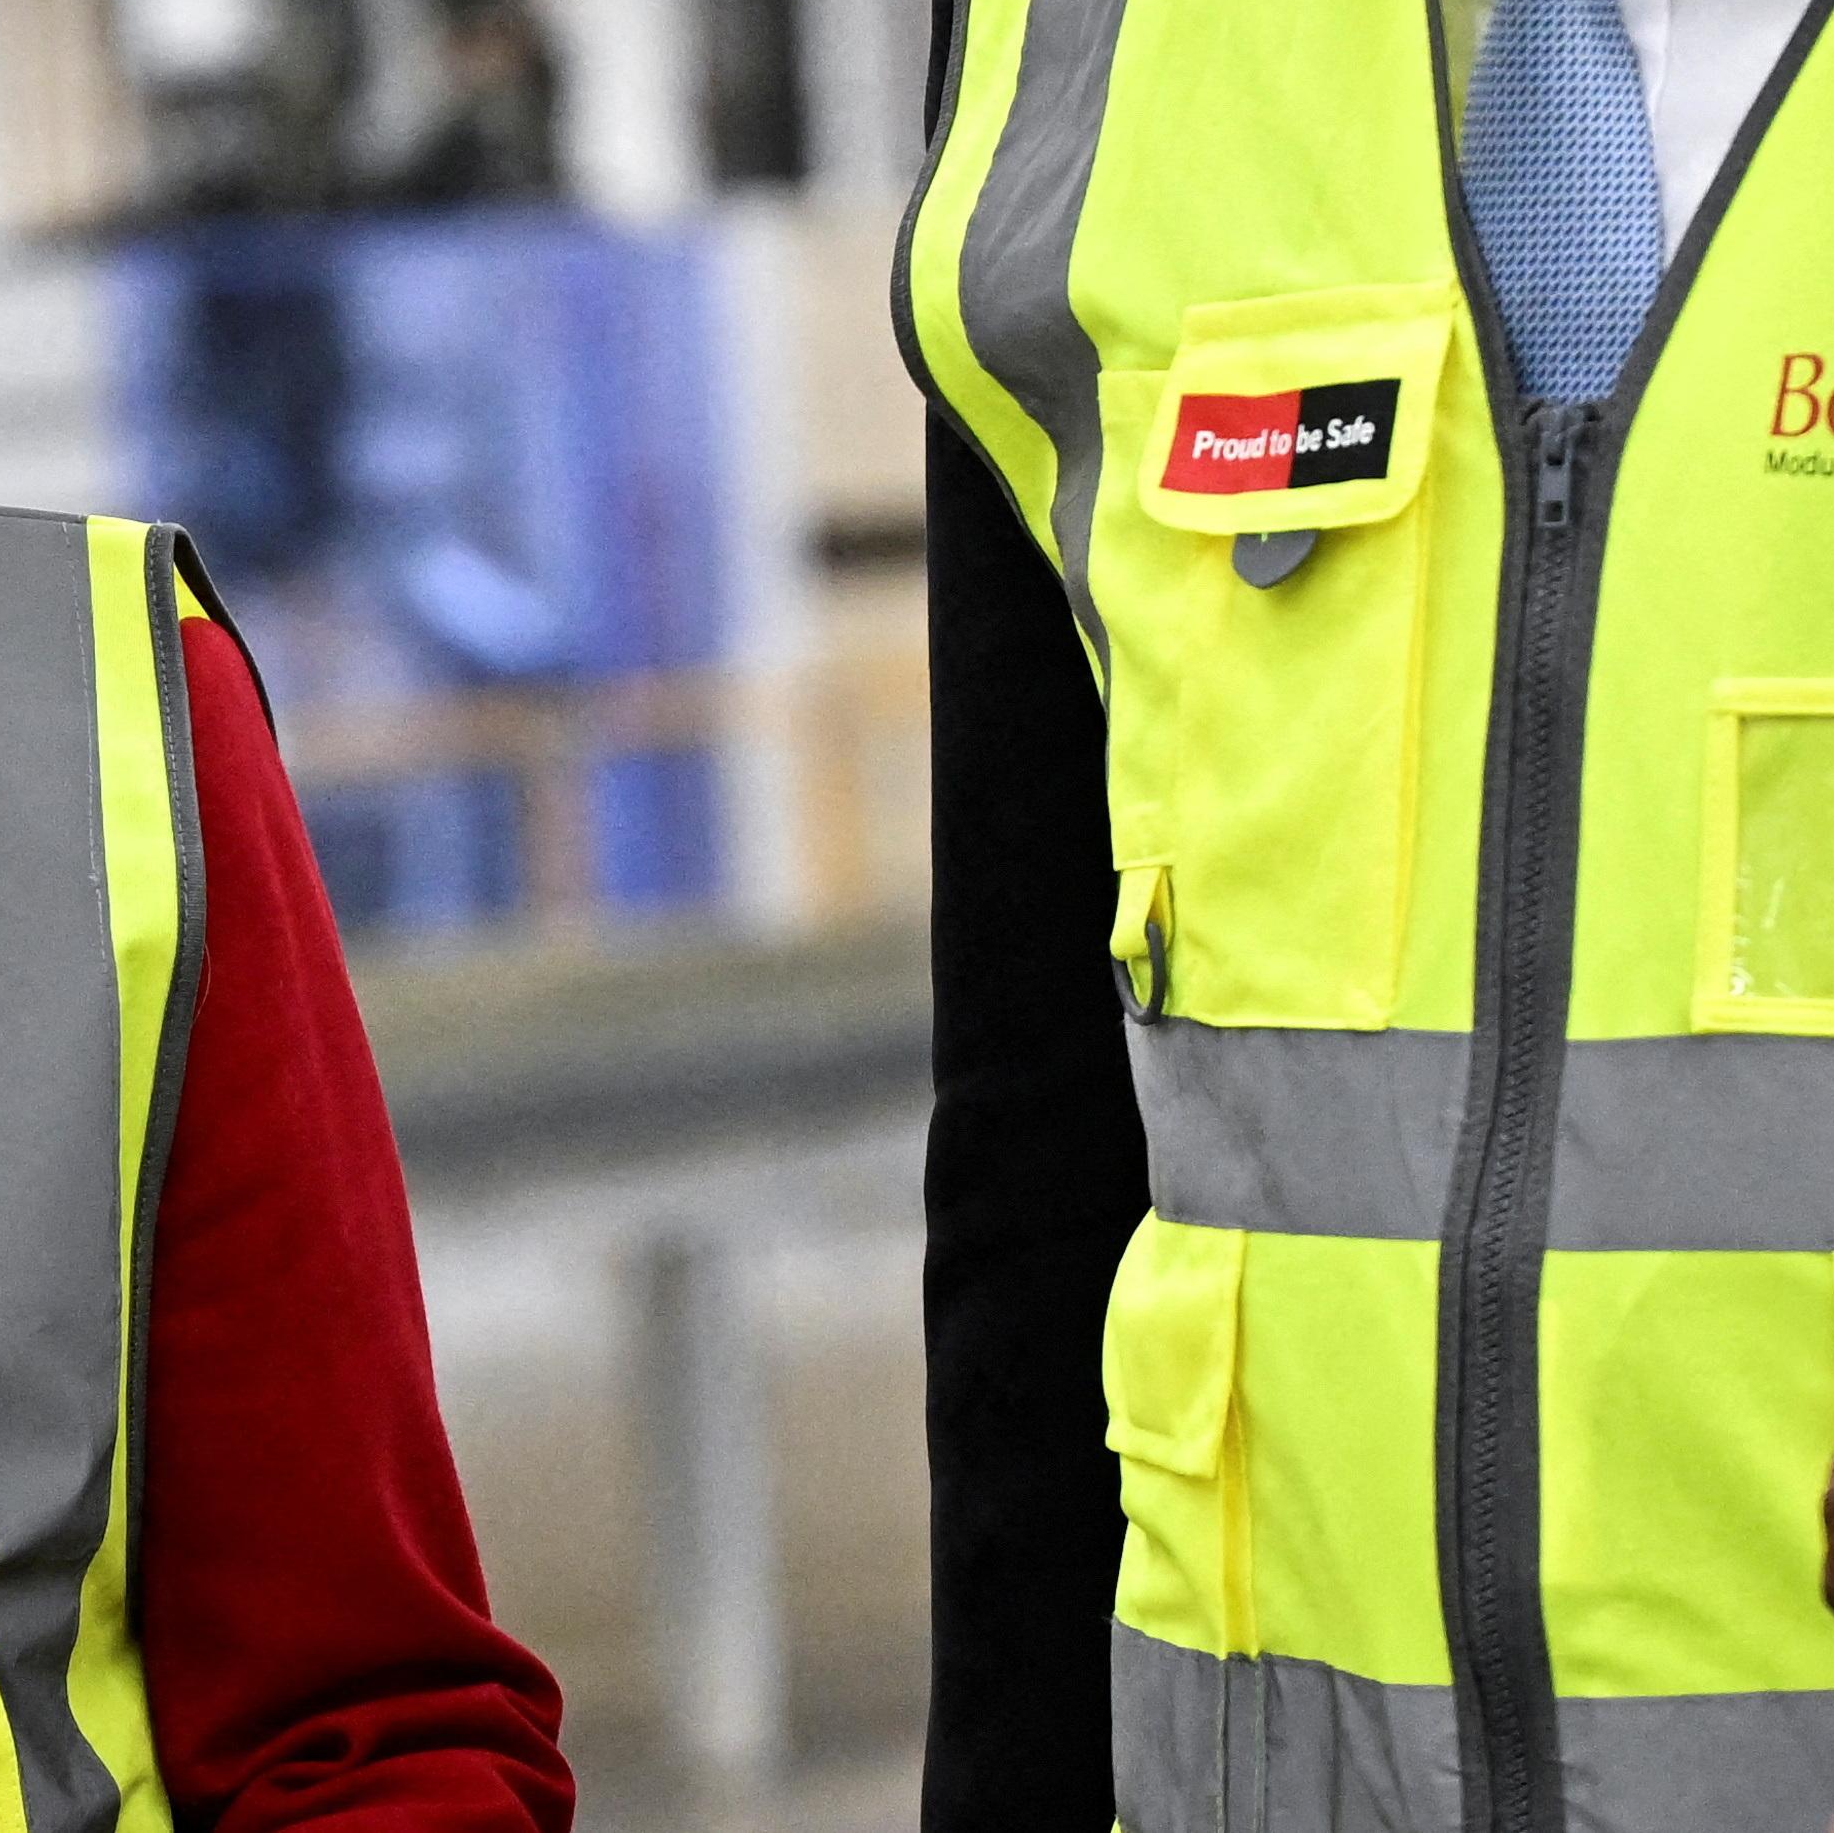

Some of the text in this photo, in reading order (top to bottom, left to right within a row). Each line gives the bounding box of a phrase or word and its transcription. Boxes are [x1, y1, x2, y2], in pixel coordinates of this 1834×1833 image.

[1192, 415, 1376, 462] Proud to be Safe
